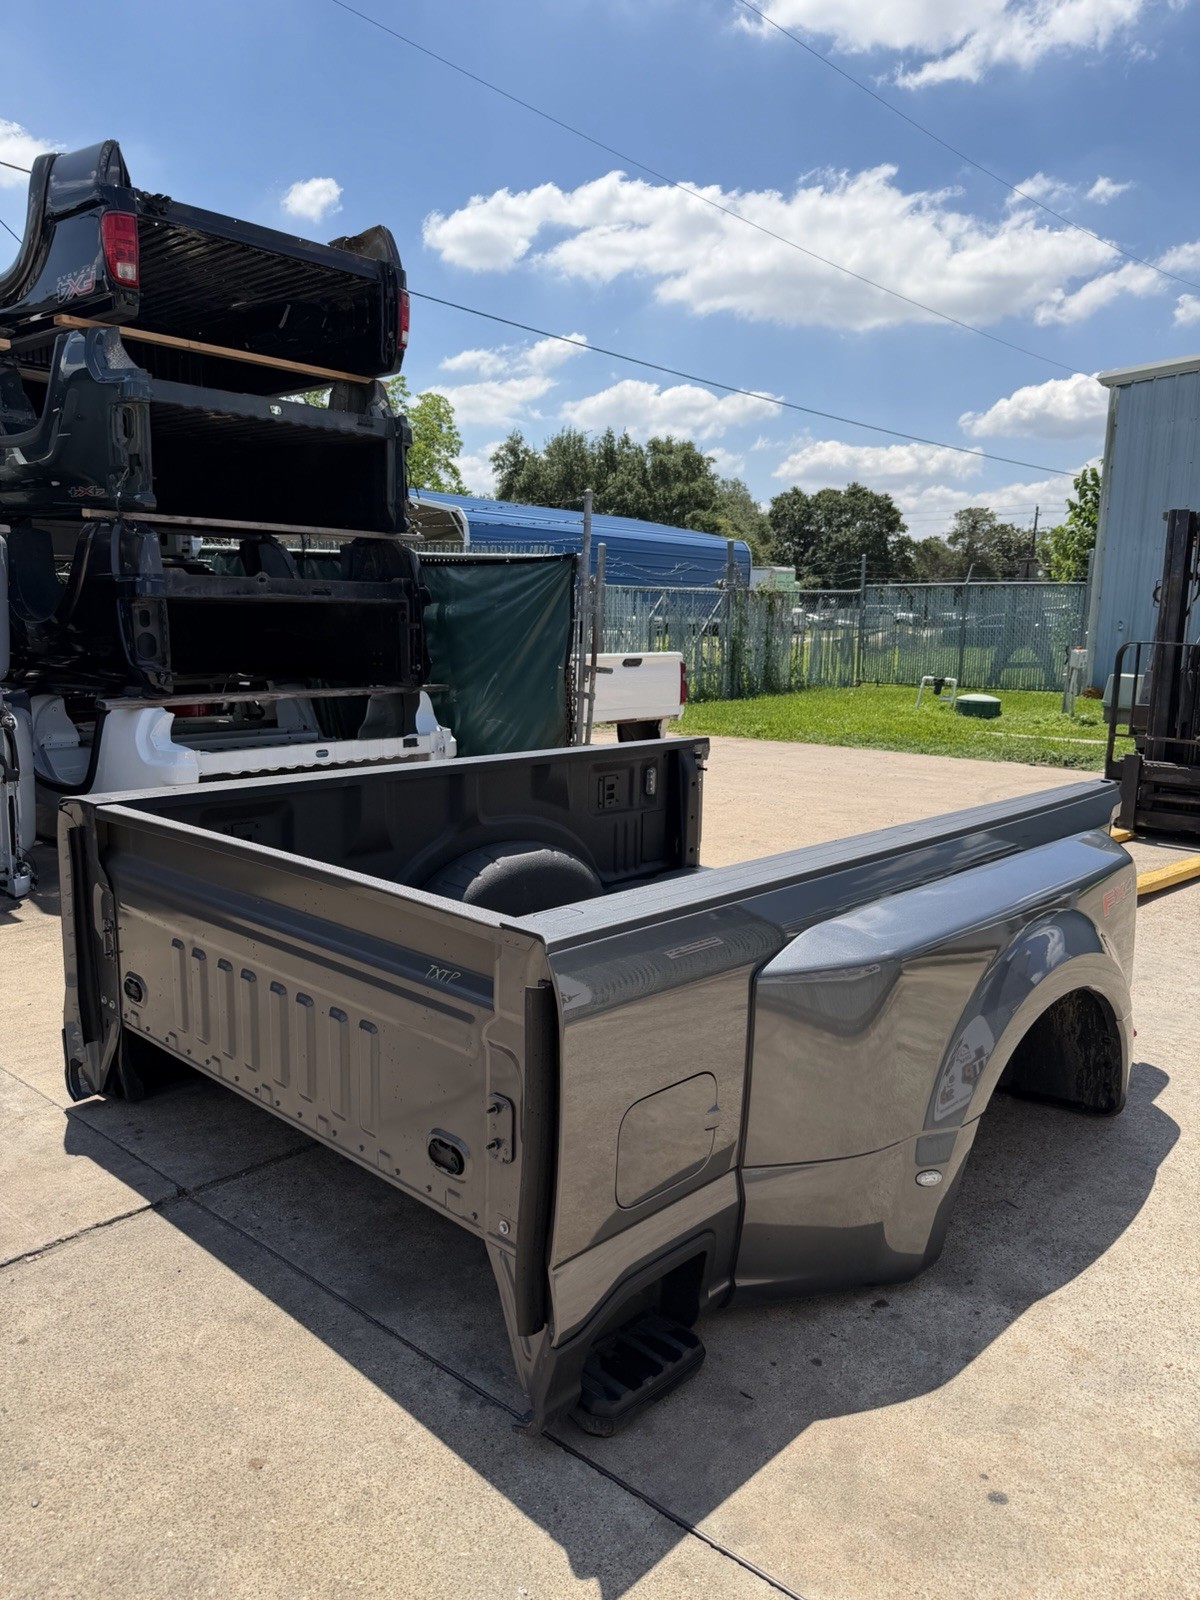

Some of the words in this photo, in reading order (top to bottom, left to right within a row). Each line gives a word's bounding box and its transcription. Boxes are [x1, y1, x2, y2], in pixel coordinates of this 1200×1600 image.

[57, 270, 96, 304] FX4
[1102, 878, 1134, 920] FX4
[425, 964, 461, 985] TXTP
